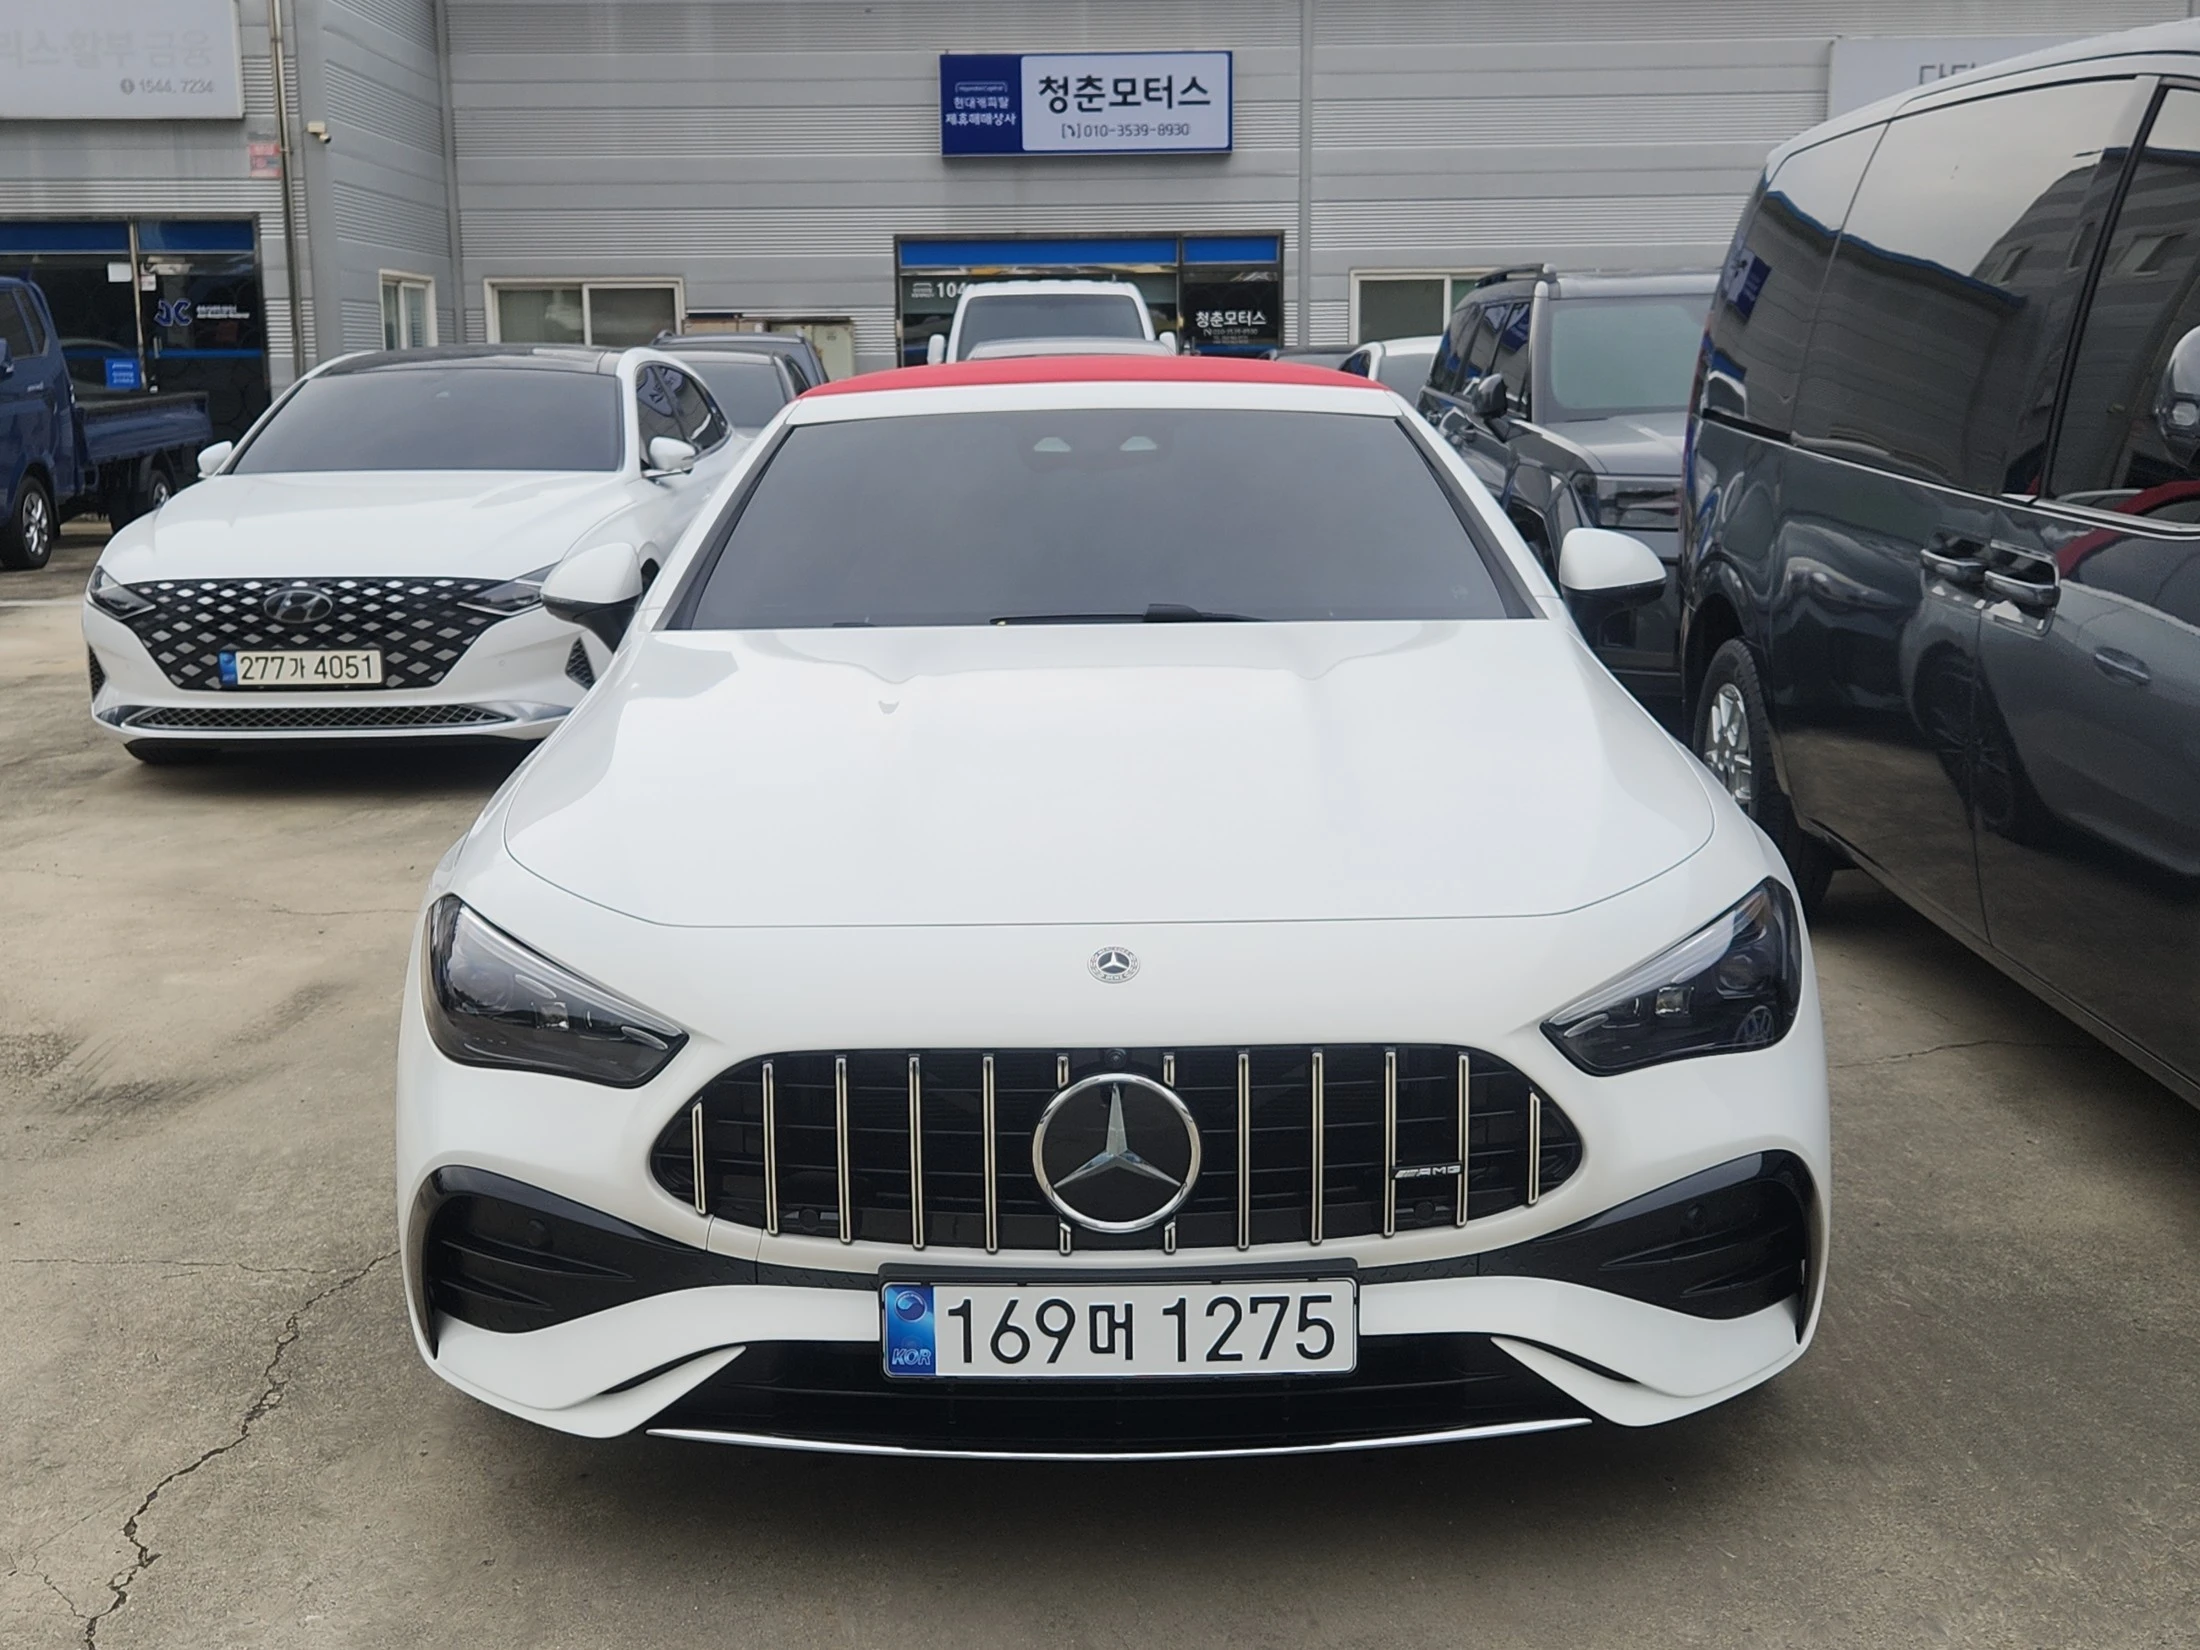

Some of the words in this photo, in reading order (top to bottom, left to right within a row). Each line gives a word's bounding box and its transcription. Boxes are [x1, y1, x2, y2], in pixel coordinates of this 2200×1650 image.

[1038, 75, 1211, 114] 청춘모터스
[1196, 311, 1266, 328] 청춘모터스
[240, 656, 305, 680] 277가
[314, 655, 372, 679] 4051
[1415, 1165, 1461, 1176] AMG
[947, 1297, 1134, 1364] 169머
[1162, 1294, 1335, 1363] 1275
[892, 1348, 931, 1366] KOR
